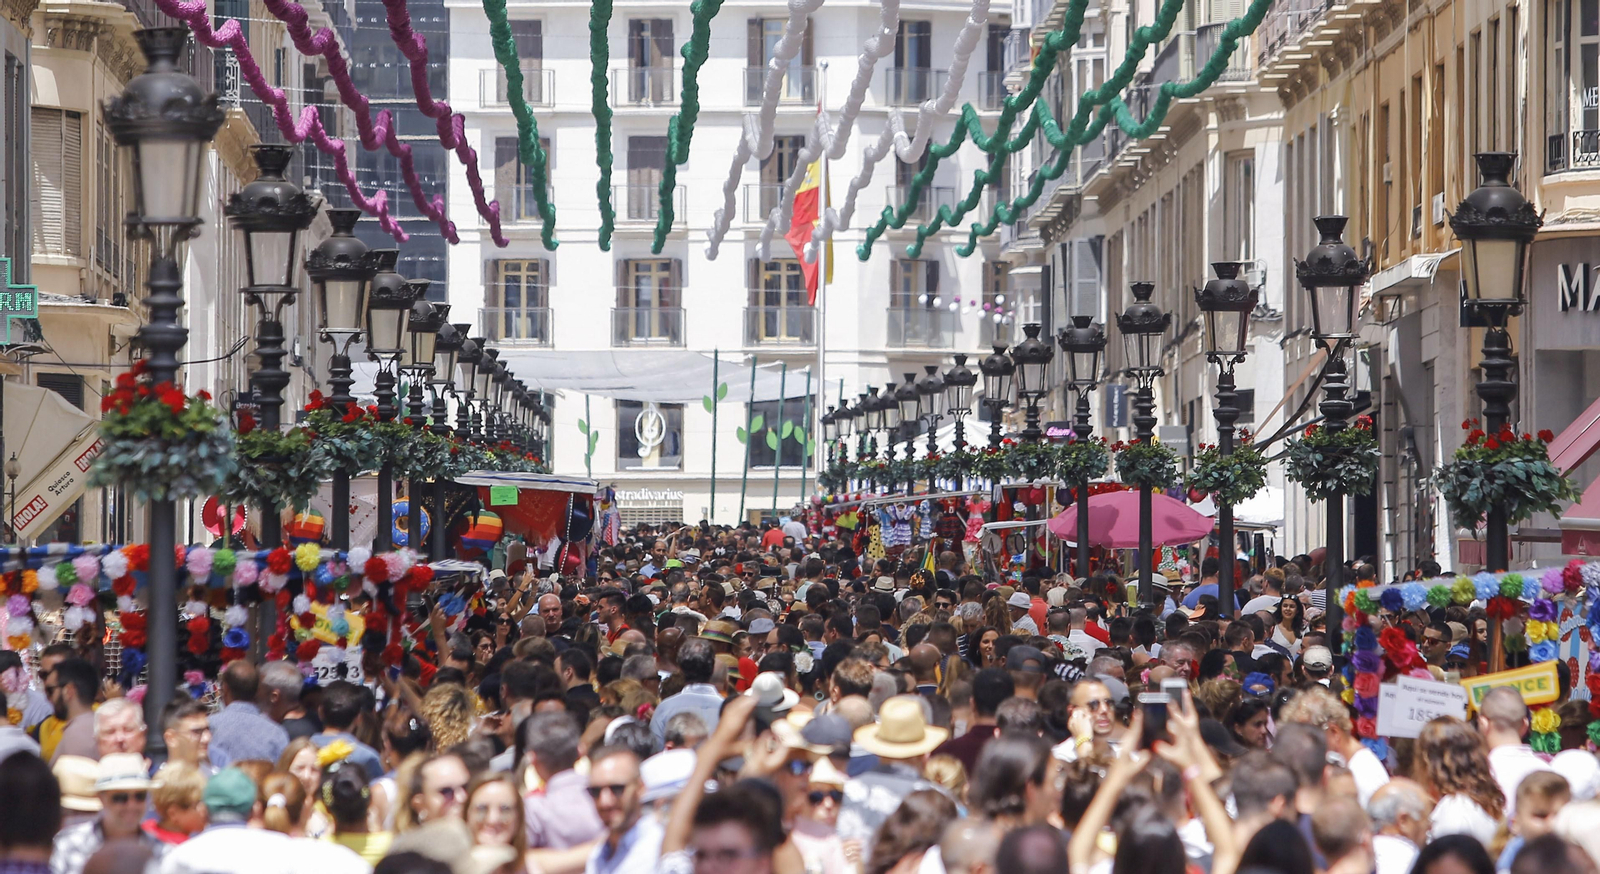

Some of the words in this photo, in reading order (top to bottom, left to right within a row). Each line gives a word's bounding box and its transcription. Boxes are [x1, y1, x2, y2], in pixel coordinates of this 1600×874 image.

[47, 471, 71, 492] Quiosco
[54, 478, 75, 496] Arturo
[614, 487, 684, 501] stradivarius
[14, 495, 47, 529] ¡HOLA!
